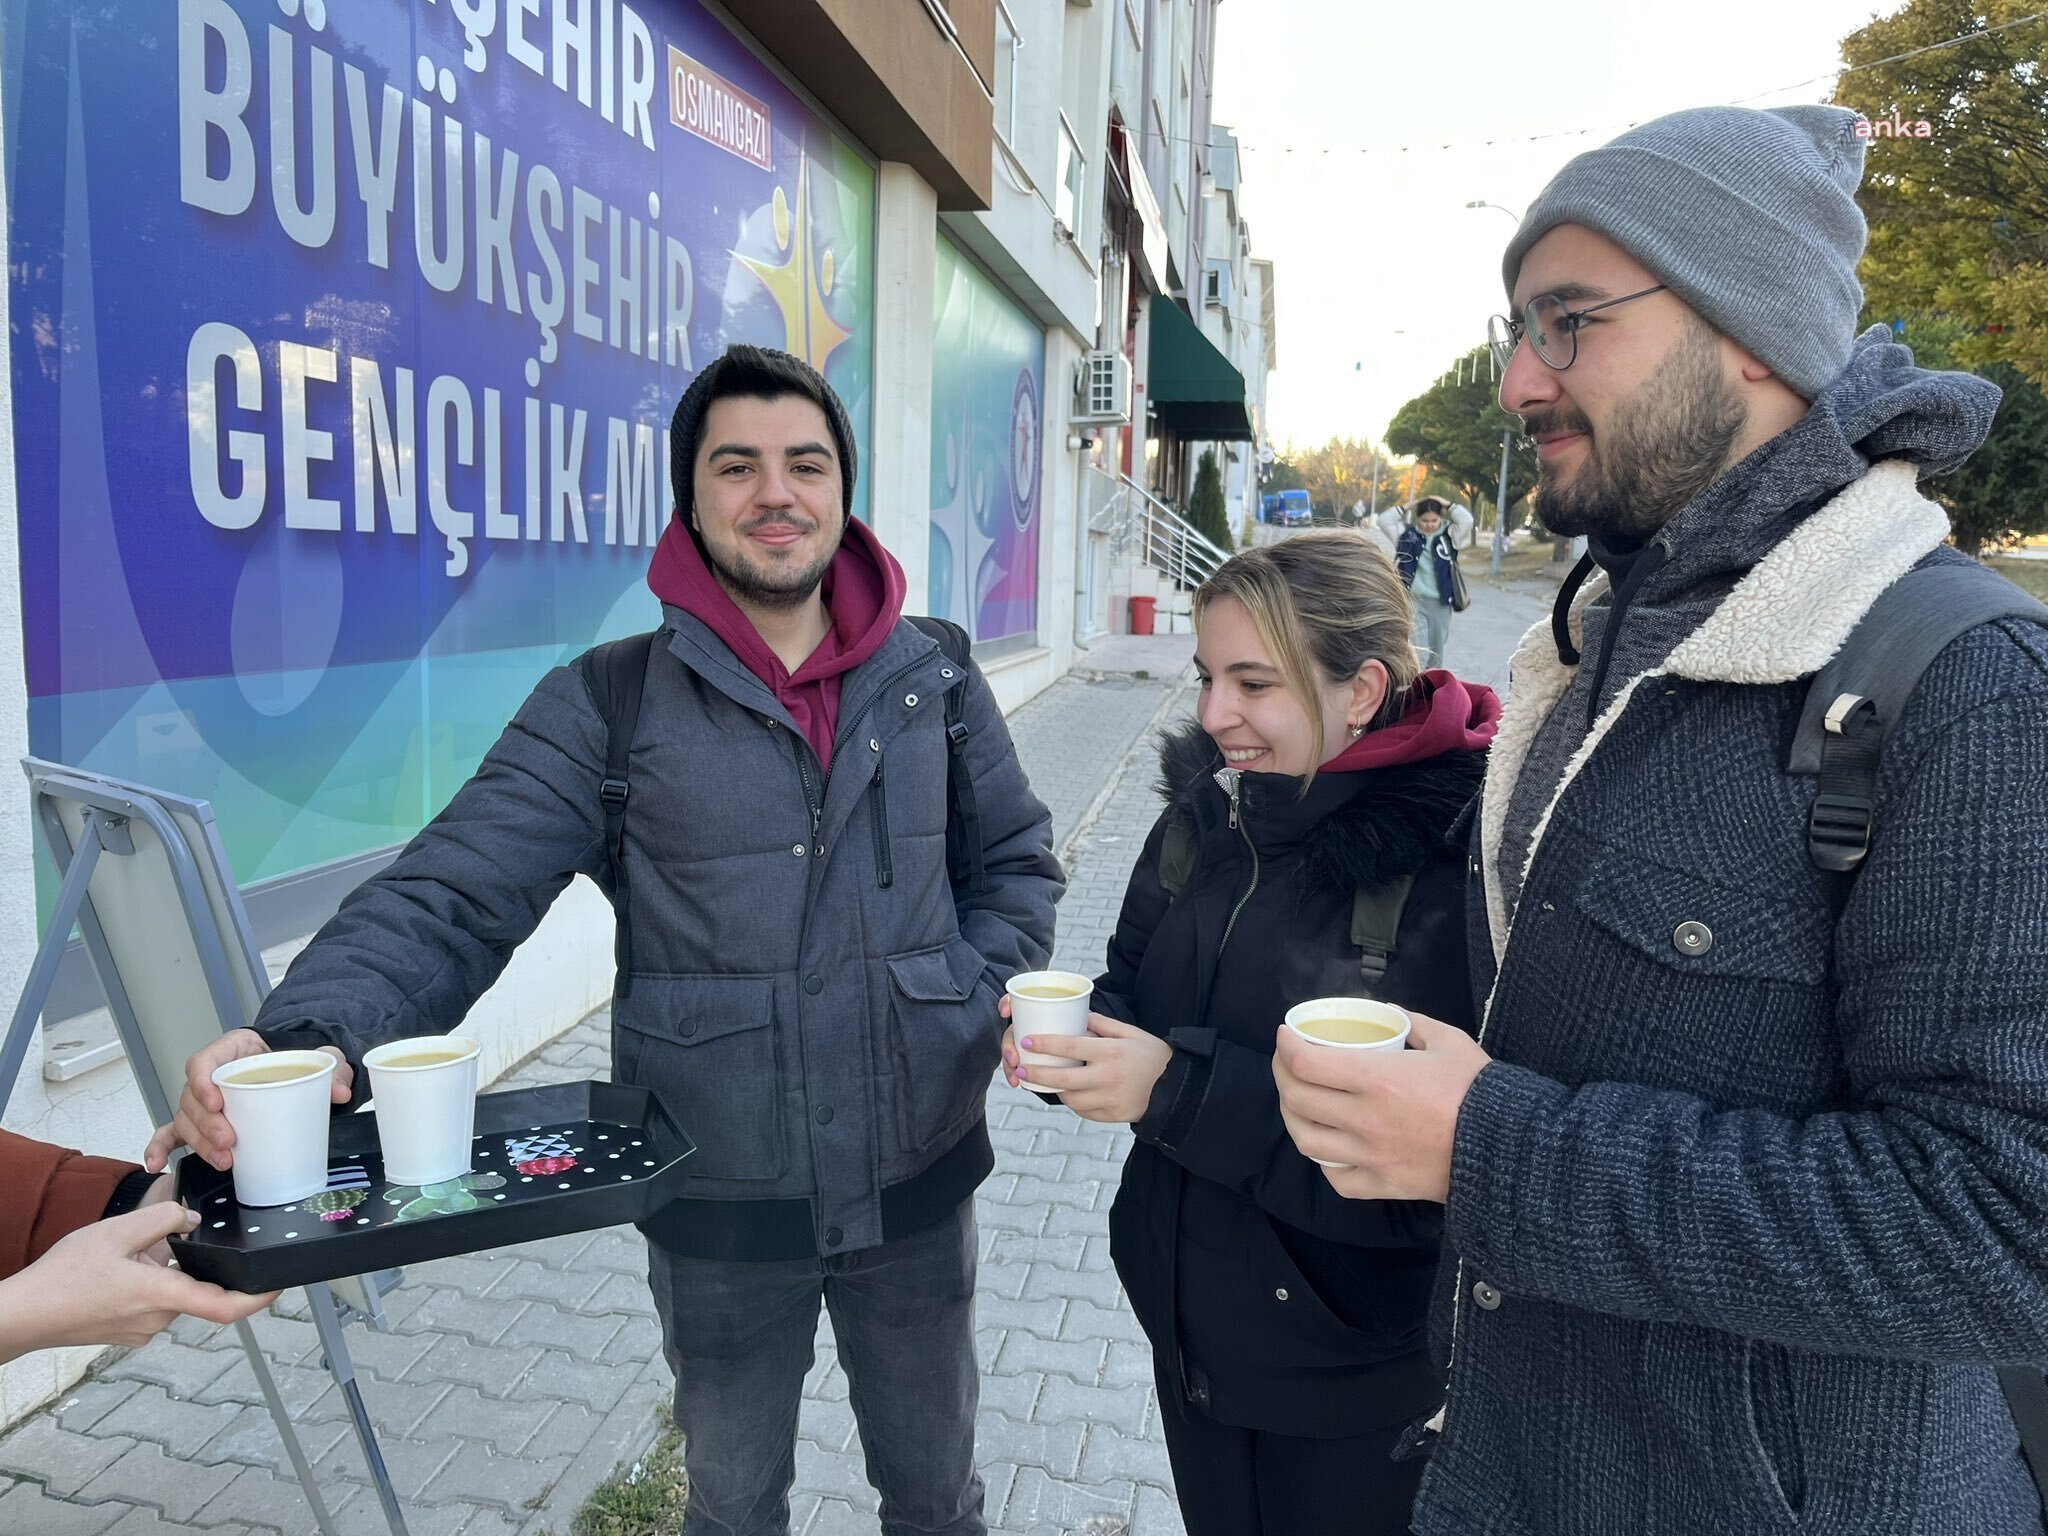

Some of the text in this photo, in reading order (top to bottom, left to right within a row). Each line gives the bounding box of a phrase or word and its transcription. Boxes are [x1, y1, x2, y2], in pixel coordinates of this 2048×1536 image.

[178, 0, 693, 373] BÜYÜKŞEHİR
[675, 65, 767, 162] OSMANGAZİ
[186, 321, 589, 578] GENÇLİK
